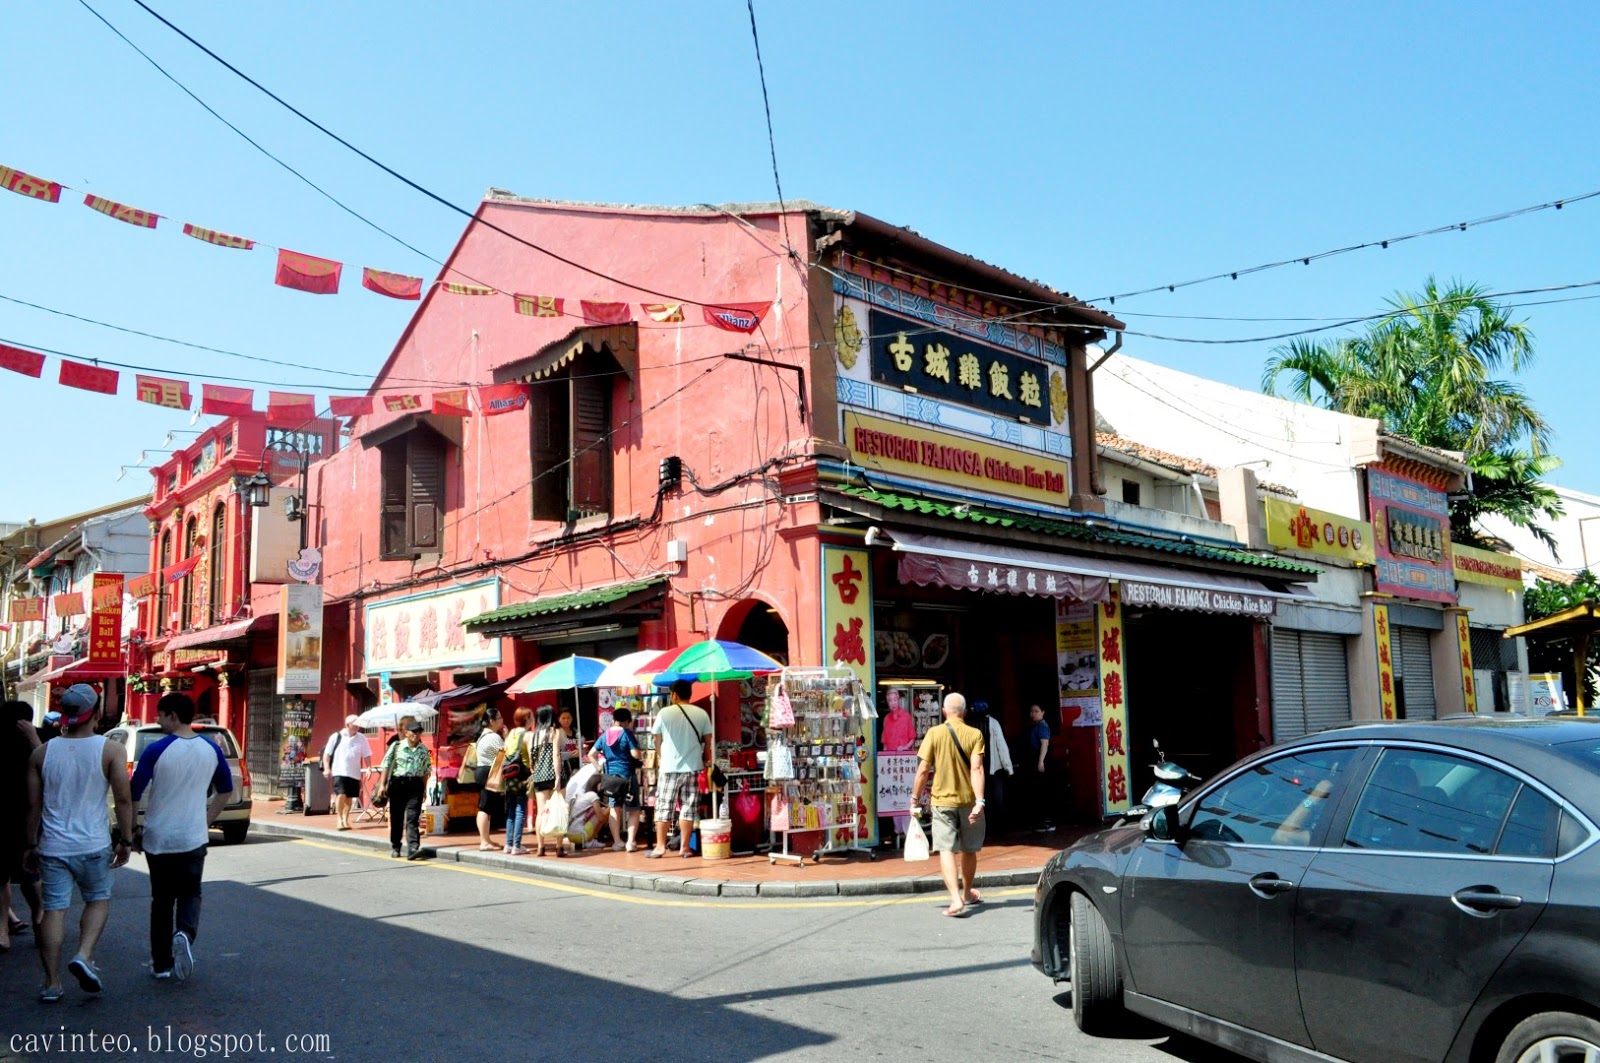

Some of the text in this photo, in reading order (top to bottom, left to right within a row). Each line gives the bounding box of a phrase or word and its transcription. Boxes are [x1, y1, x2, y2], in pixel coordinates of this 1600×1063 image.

[888, 332, 1042, 408] 古城雞飯粒
[854, 427, 1065, 493] RESTORAN FAMOSA Chicken Rice Ball
[1127, 583, 1273, 613] RESTORAN FAMOSA Chicken Rice Ball
[99, 616, 114, 625] Rice
[99, 627, 113, 637] Ball
